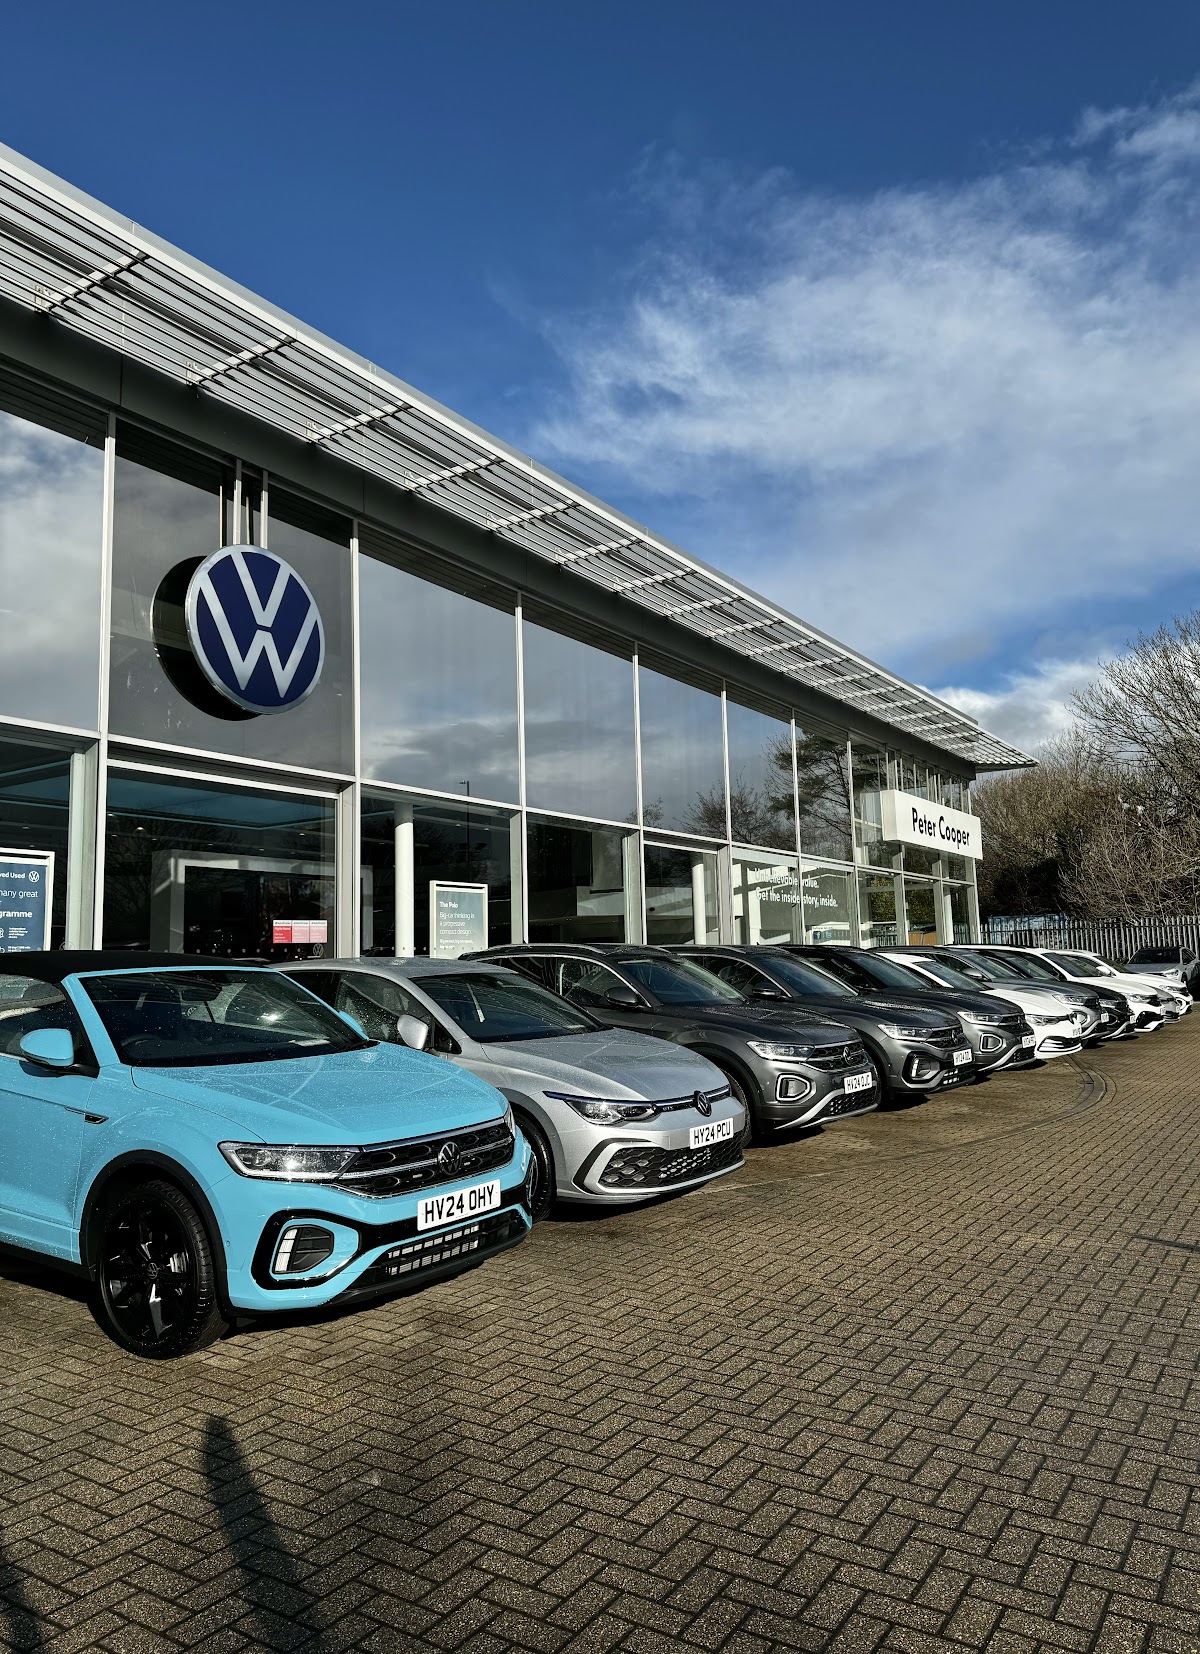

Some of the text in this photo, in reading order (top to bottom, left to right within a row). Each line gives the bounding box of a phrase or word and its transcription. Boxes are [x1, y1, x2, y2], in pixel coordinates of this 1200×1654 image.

[911, 807, 970, 849] Peter Cooper
[18, 890, 38, 899] great
[756, 887, 769, 901] Get
[770, 889, 781, 902] the
[781, 890, 800, 903] inside
[693, 1120, 731, 1145] HY24 PCU
[424, 1184, 495, 1224] HV24 OHY
